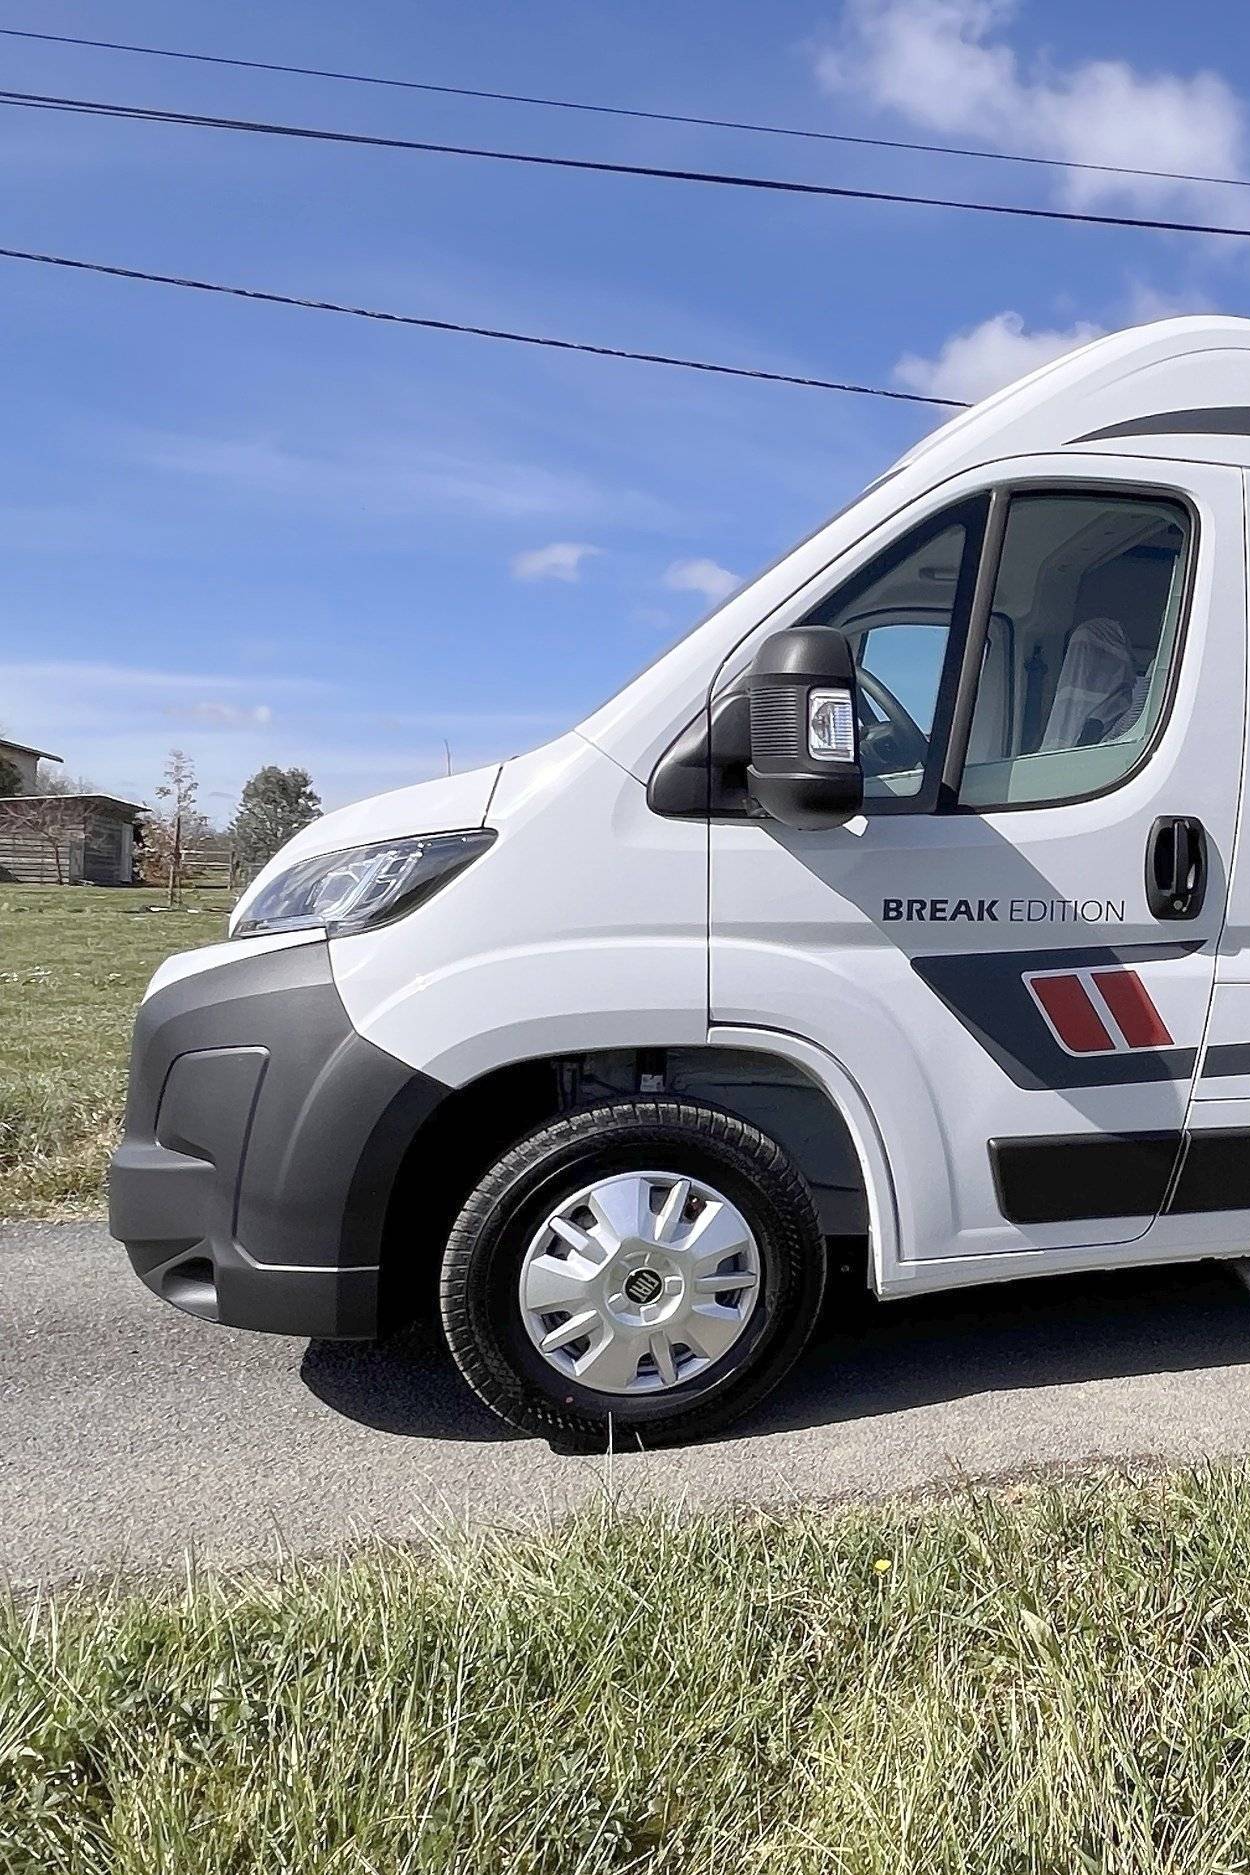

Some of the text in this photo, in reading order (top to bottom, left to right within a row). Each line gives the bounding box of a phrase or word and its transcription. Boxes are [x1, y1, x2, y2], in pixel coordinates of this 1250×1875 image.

[882, 898, 1126, 923] BREAK EDITION
[629, 1272, 659, 1301] FIAT
